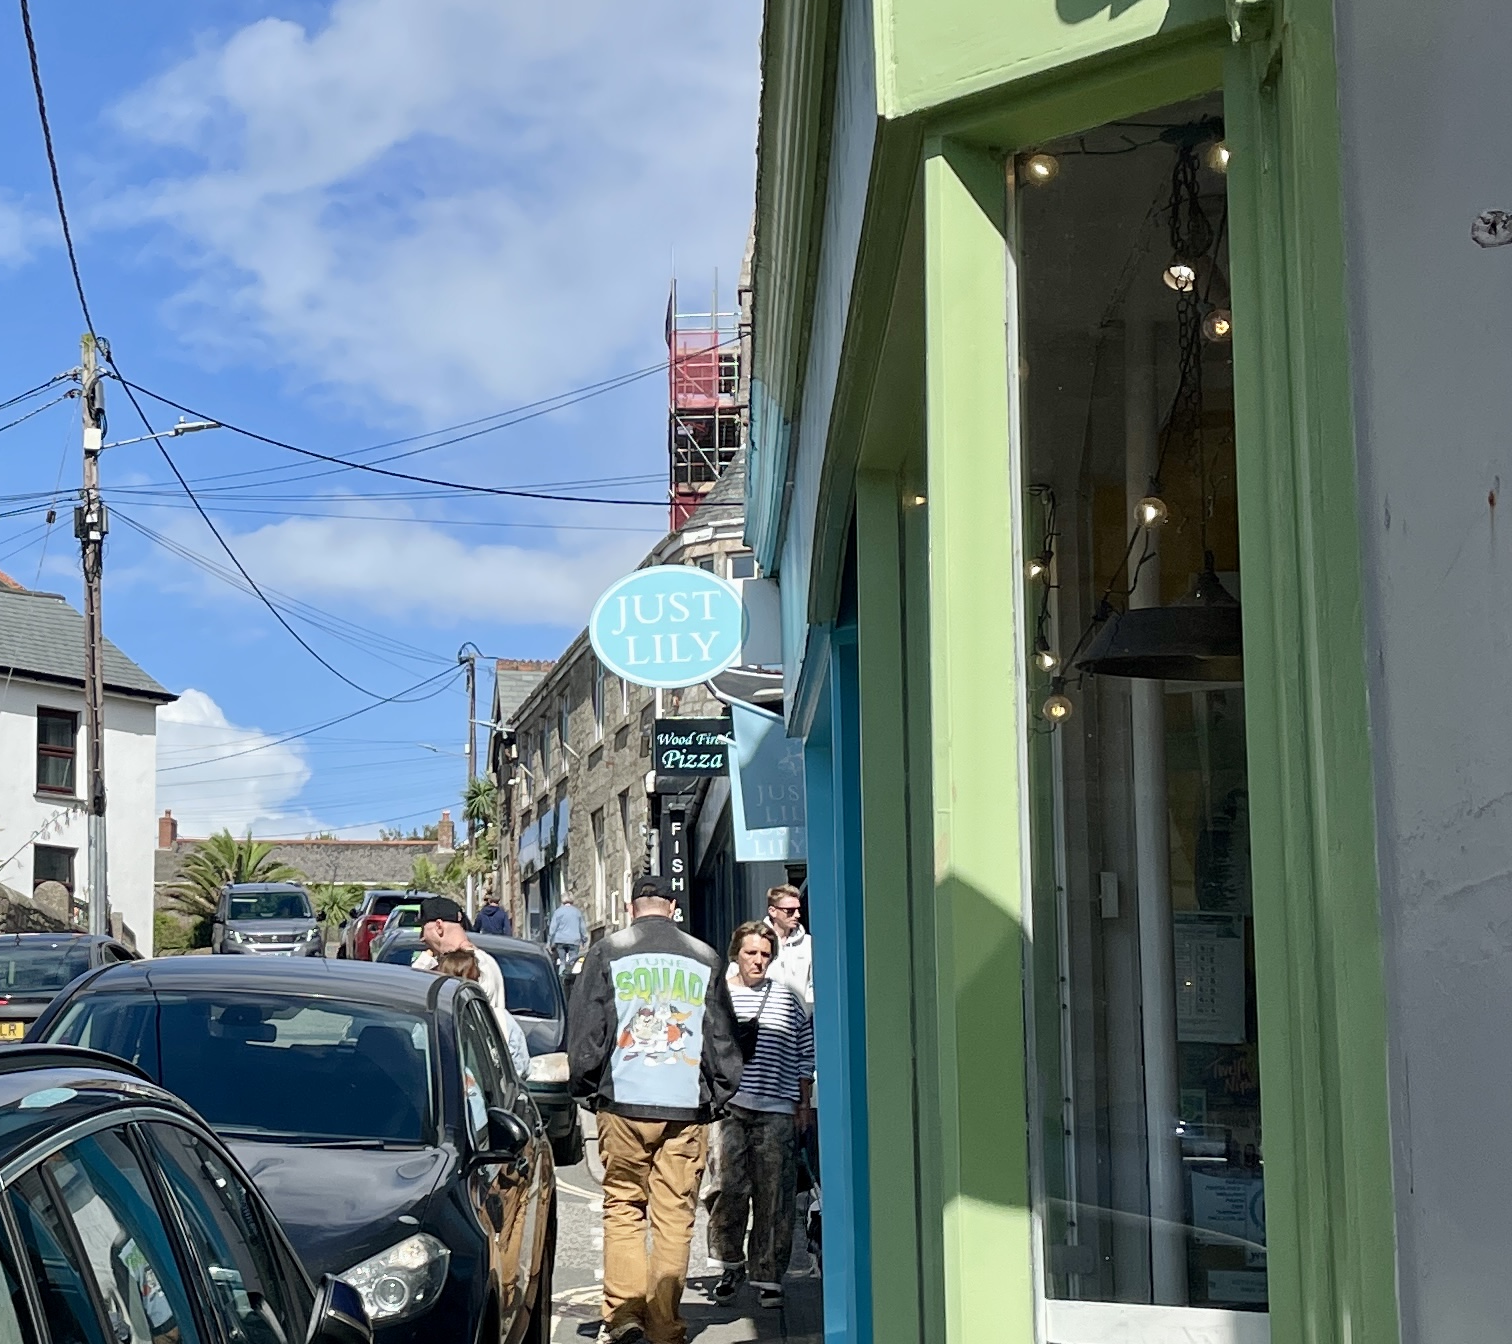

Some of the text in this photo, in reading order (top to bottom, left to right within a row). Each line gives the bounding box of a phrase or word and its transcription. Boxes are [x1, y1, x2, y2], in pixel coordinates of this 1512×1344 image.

[611, 589, 722, 636] JUST
[624, 630, 721, 666] LILY
[656, 731, 697, 746] Wood
[661, 748, 724, 769] Pizza
[756, 784, 800, 807] JUS
[765, 805, 803, 823] LIL
[671, 821, 684, 892] FISH
[754, 839, 804, 856] LILY
[631, 957, 689, 968] TUNE
[615, 967, 704, 1007] SQUAD
